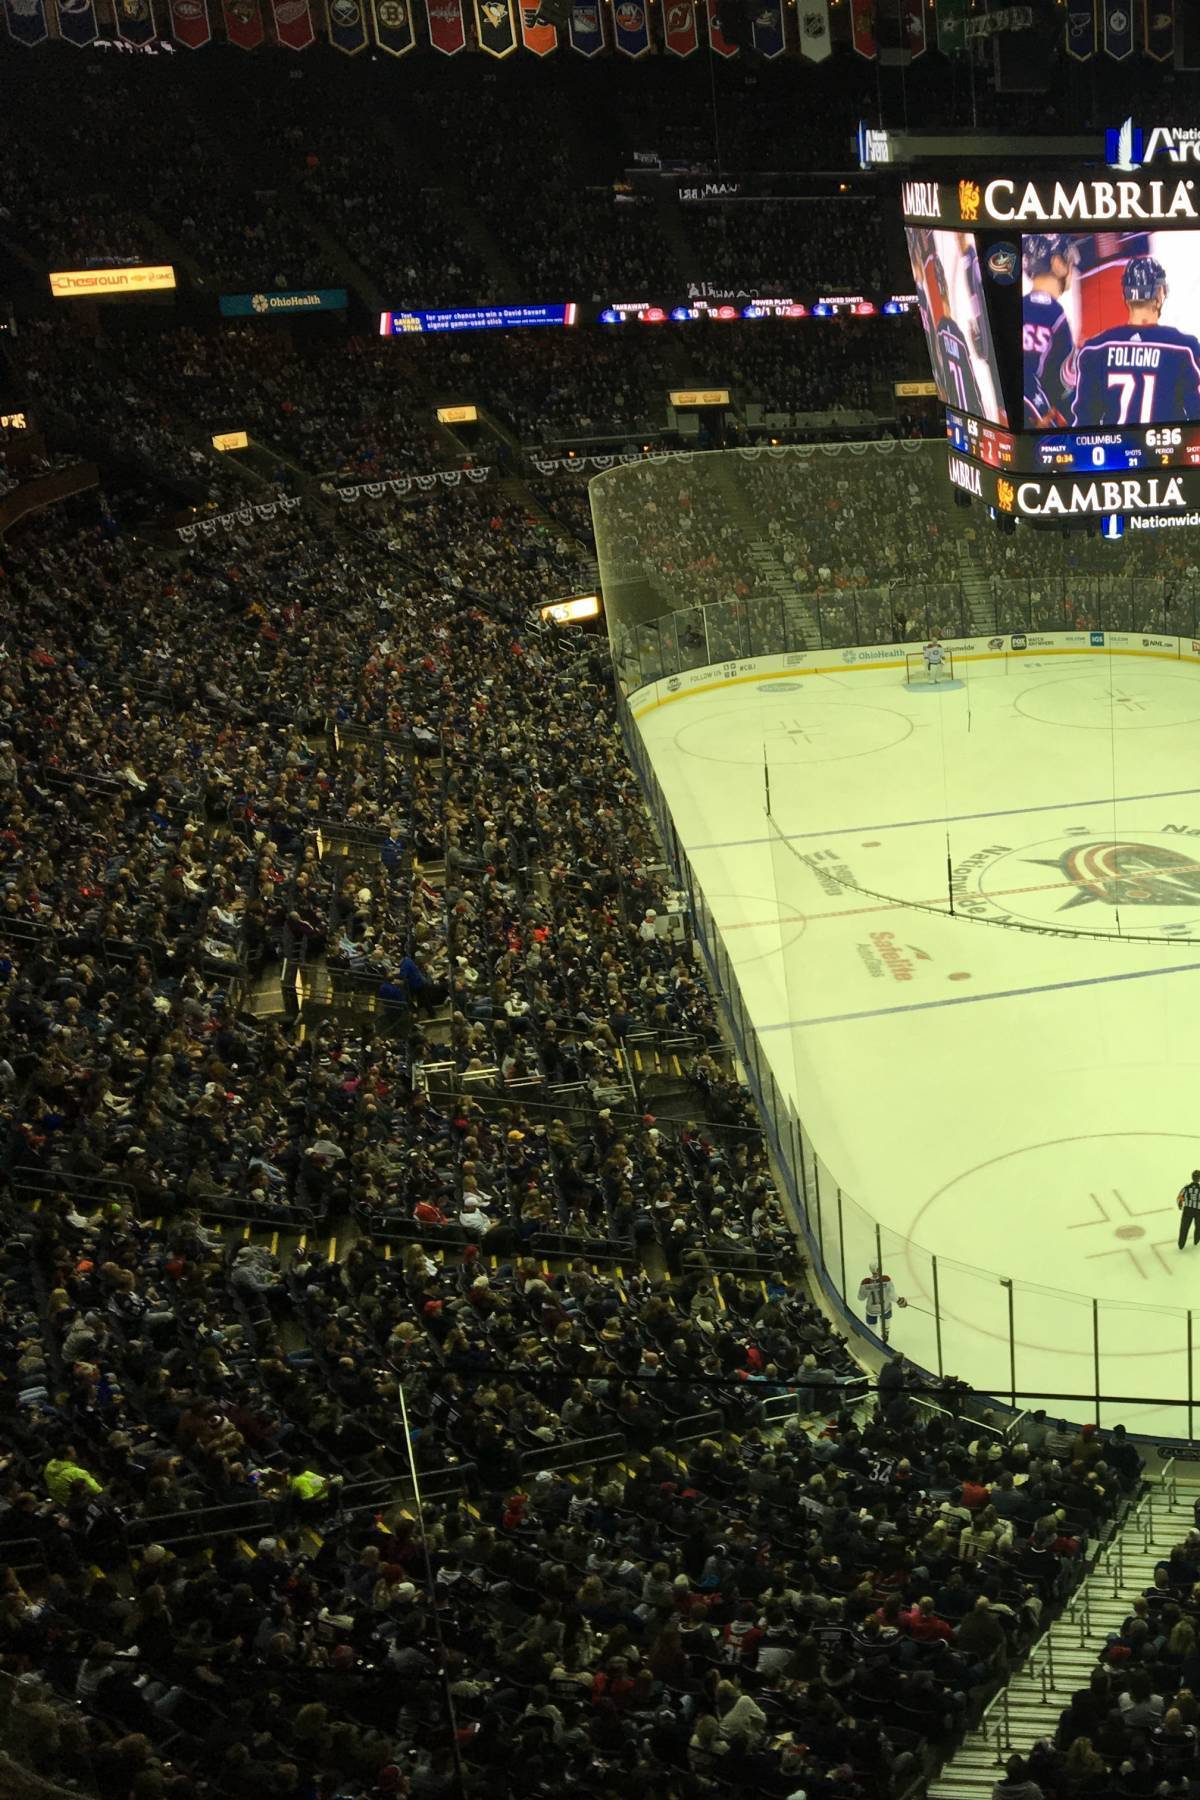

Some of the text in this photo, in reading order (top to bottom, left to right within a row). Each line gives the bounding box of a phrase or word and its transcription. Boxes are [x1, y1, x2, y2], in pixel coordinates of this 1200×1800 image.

[984, 179, 1198, 220] CAMBRIA
[270, 295, 321, 307] OhioHealth
[774, 298, 793, 306] PLAYS
[453, 312, 476, 320] chance
[504, 309, 522, 317] David
[523, 308, 547, 316] Savard
[688, 308, 719, 319] 10 10
[427, 321, 449, 329] signed
[487, 318, 503, 326] stick
[1107, 346, 1160, 368] FOLIGNO
[1107, 372, 1157, 424] 71
[1076, 434, 1122, 446] COLUMBUS
[1145, 428, 1182, 447] 6:36
[1042, 455, 1053, 464] 77
[1092, 446, 1105, 466] 0
[1161, 455, 1169, 465] 2
[1017, 477, 1186, 515] CAMBRIA
[859, 649, 906, 660] OhioHealth
[690, 672, 713, 683] FOLLOW
